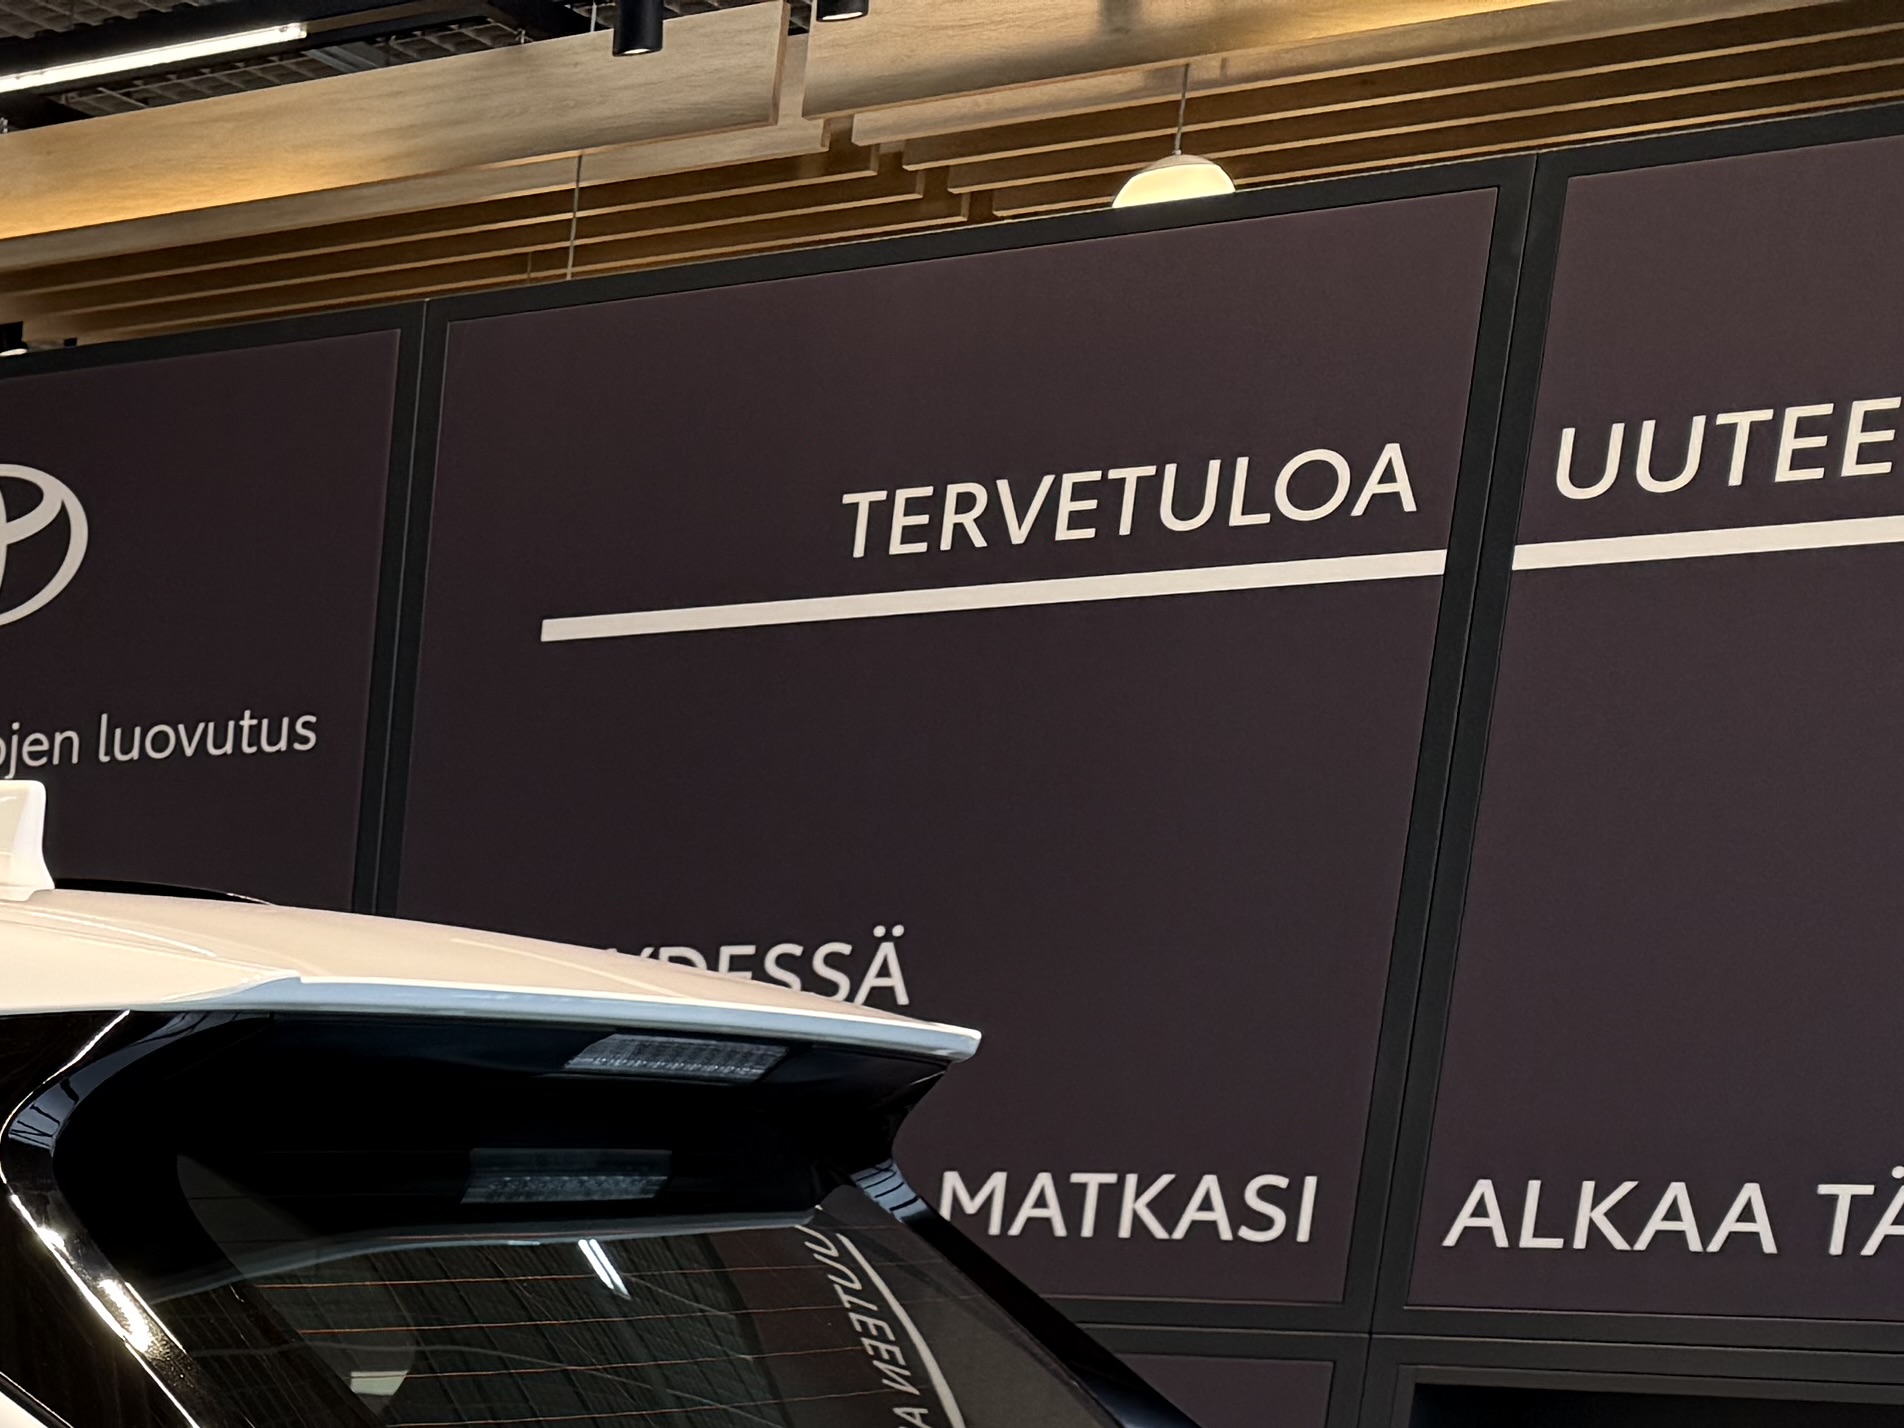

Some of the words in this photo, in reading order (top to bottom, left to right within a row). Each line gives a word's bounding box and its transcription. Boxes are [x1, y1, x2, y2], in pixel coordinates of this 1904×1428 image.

[1555, 396, 1903, 500] UUTEE
[842, 442, 1418, 559] TERVETULOA
[98, 709, 318, 763] luovutus
[939, 1171, 1318, 1243] MATKASI
[1442, 1178, 1778, 1254] ALKAA
